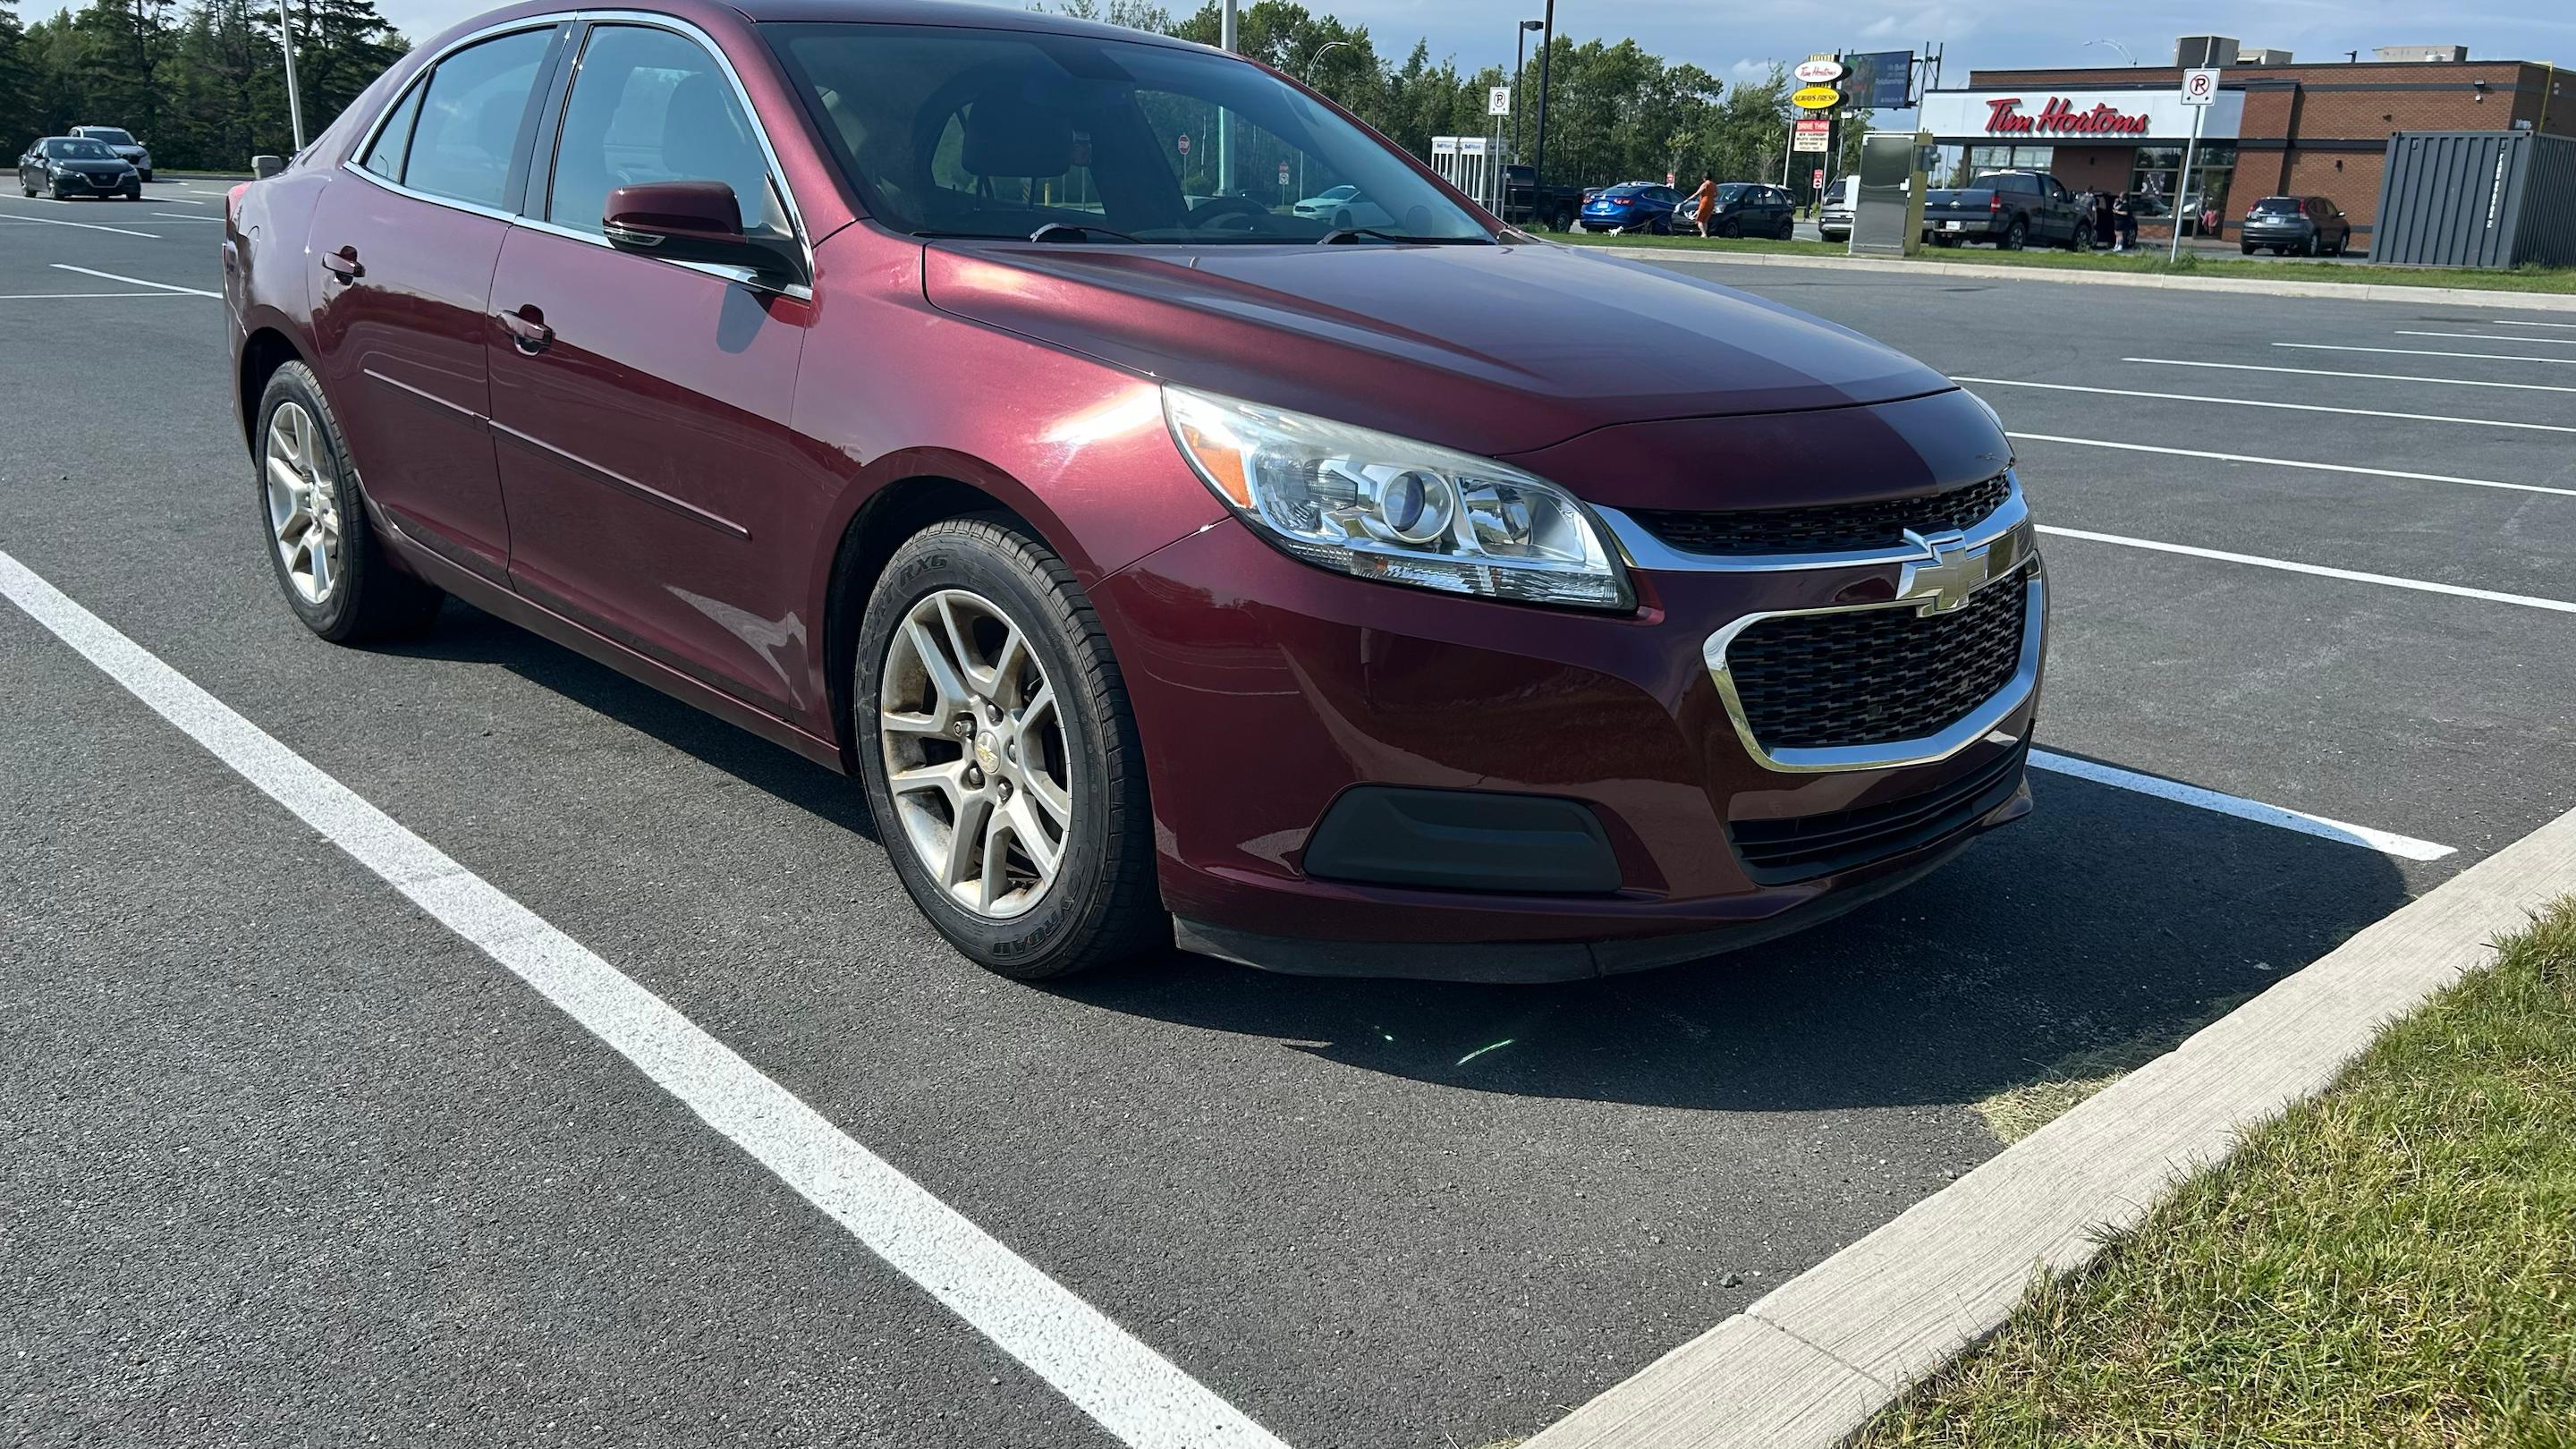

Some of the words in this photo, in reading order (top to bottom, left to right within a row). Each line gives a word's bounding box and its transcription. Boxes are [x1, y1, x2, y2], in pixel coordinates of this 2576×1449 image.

[1812, 64, 1836, 76] Hortons
[1794, 94, 1817, 102] ALWAYS
[1817, 94, 1837, 102] FRESH
[1985, 97, 2035, 133] Tim
[2035, 96, 2149, 134] Hortons
[1798, 122, 1814, 131] DRIVE
[1815, 122, 1828, 131] THRU
[899, 554, 949, 588] RX6
